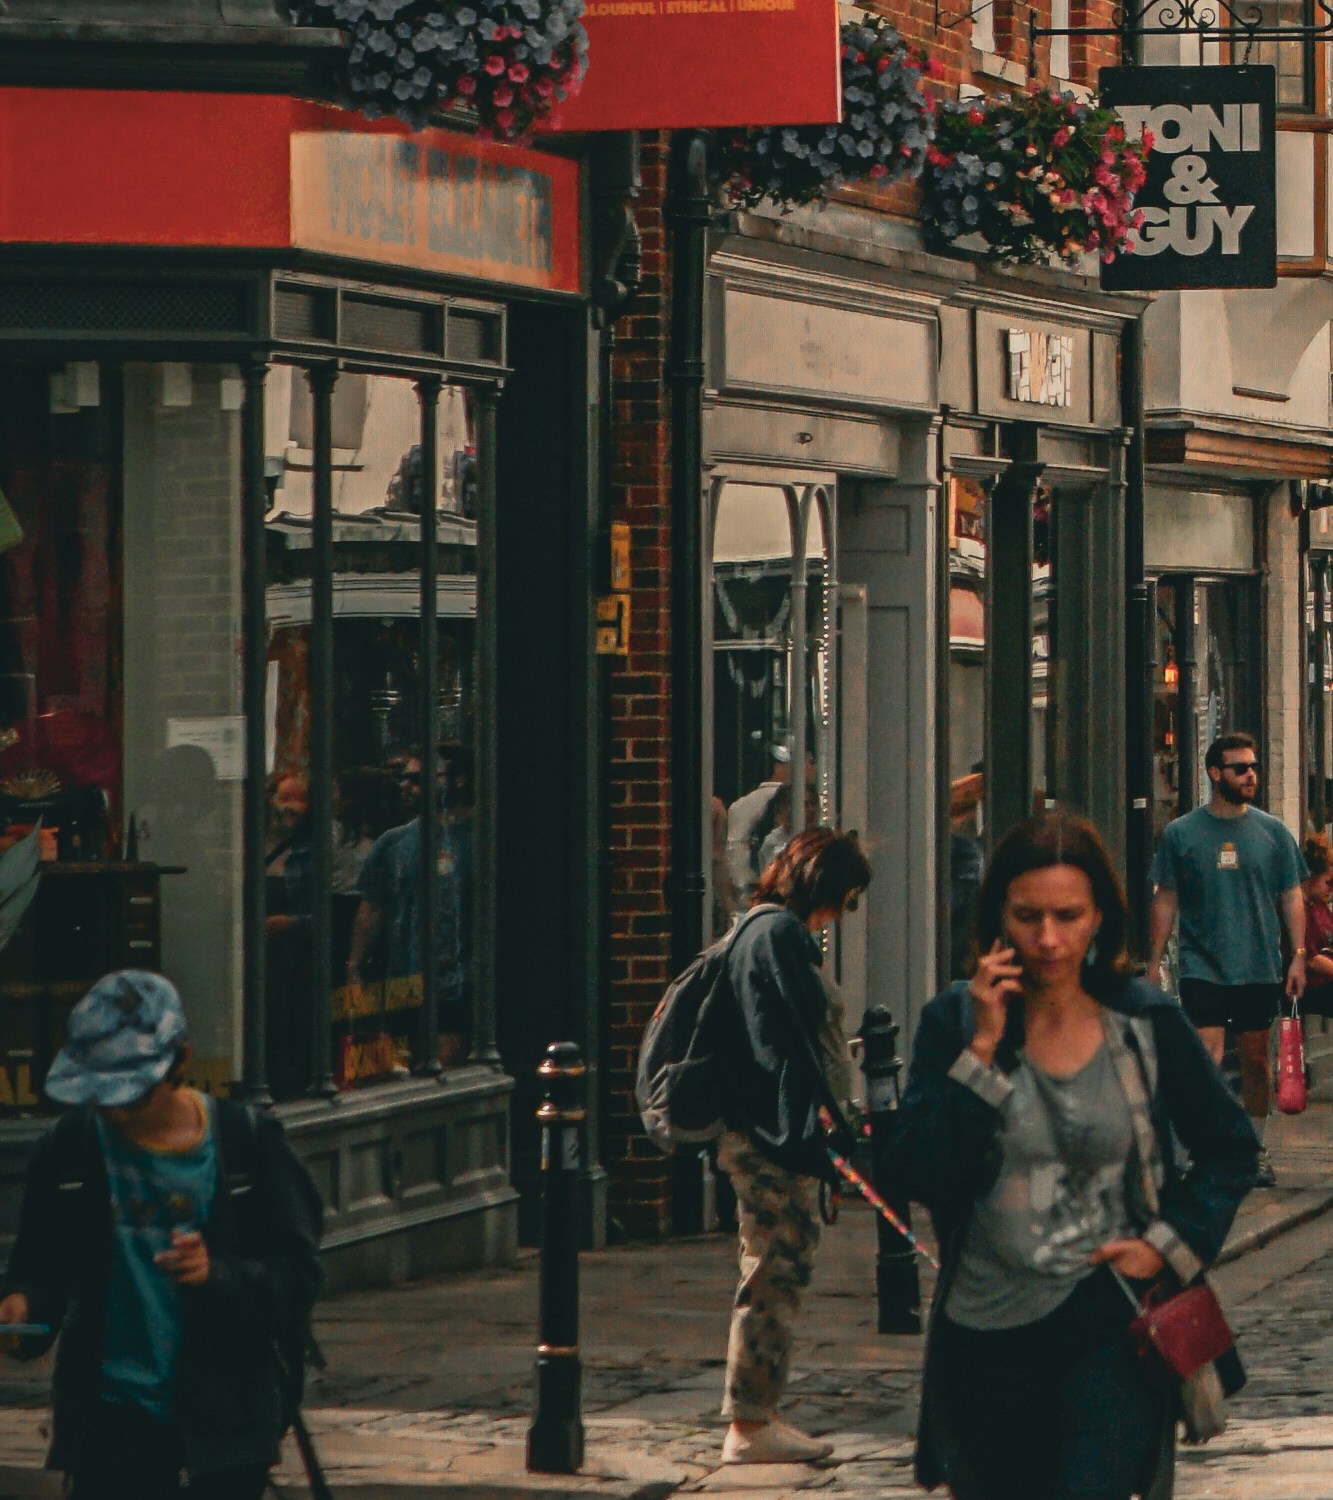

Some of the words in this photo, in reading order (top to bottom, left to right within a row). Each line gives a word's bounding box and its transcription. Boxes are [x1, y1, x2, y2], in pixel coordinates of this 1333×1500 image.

[1114, 104, 1261, 154] TONI
[1163, 154, 1222, 205] &
[1128, 205, 1256, 256] GUY
